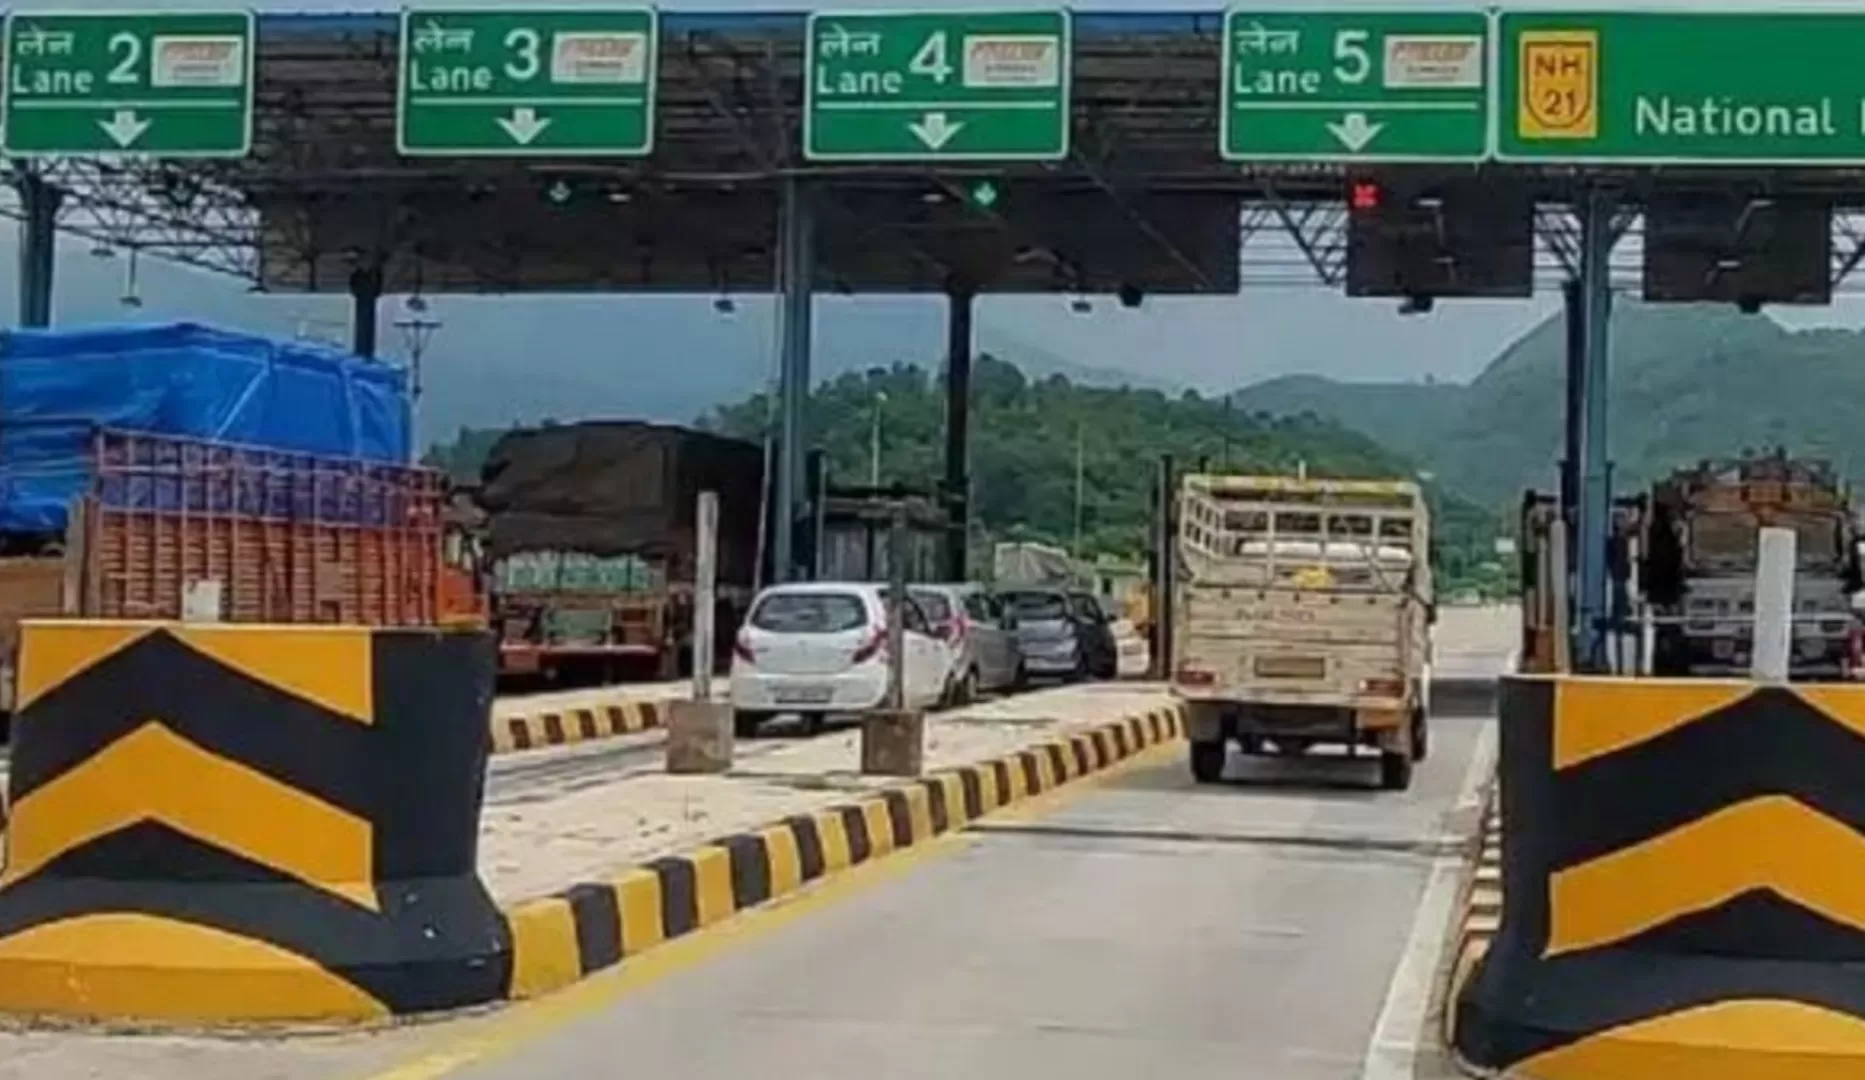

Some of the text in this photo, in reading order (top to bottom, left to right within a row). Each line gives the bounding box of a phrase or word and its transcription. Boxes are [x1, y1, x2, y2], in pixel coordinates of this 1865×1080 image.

[16, 25, 74, 56] लेन
[412, 21, 475, 53] लेन
[819, 22, 882, 57] लेन
[1235, 21, 1300, 55] लेन
[12, 64, 94, 93] Lane
[106, 31, 141, 84] 2
[410, 60, 494, 92] Lane
[503, 28, 541, 81] 3
[817, 65, 902, 95] Lane
[909, 29, 953, 85] 4
[1234, 63, 1320, 95] Lane
[1333, 29, 1371, 85] 5
[1534, 54, 1582, 76] NH
[1543, 90, 1577, 117] 21
[1635, 95, 1835, 135] National
